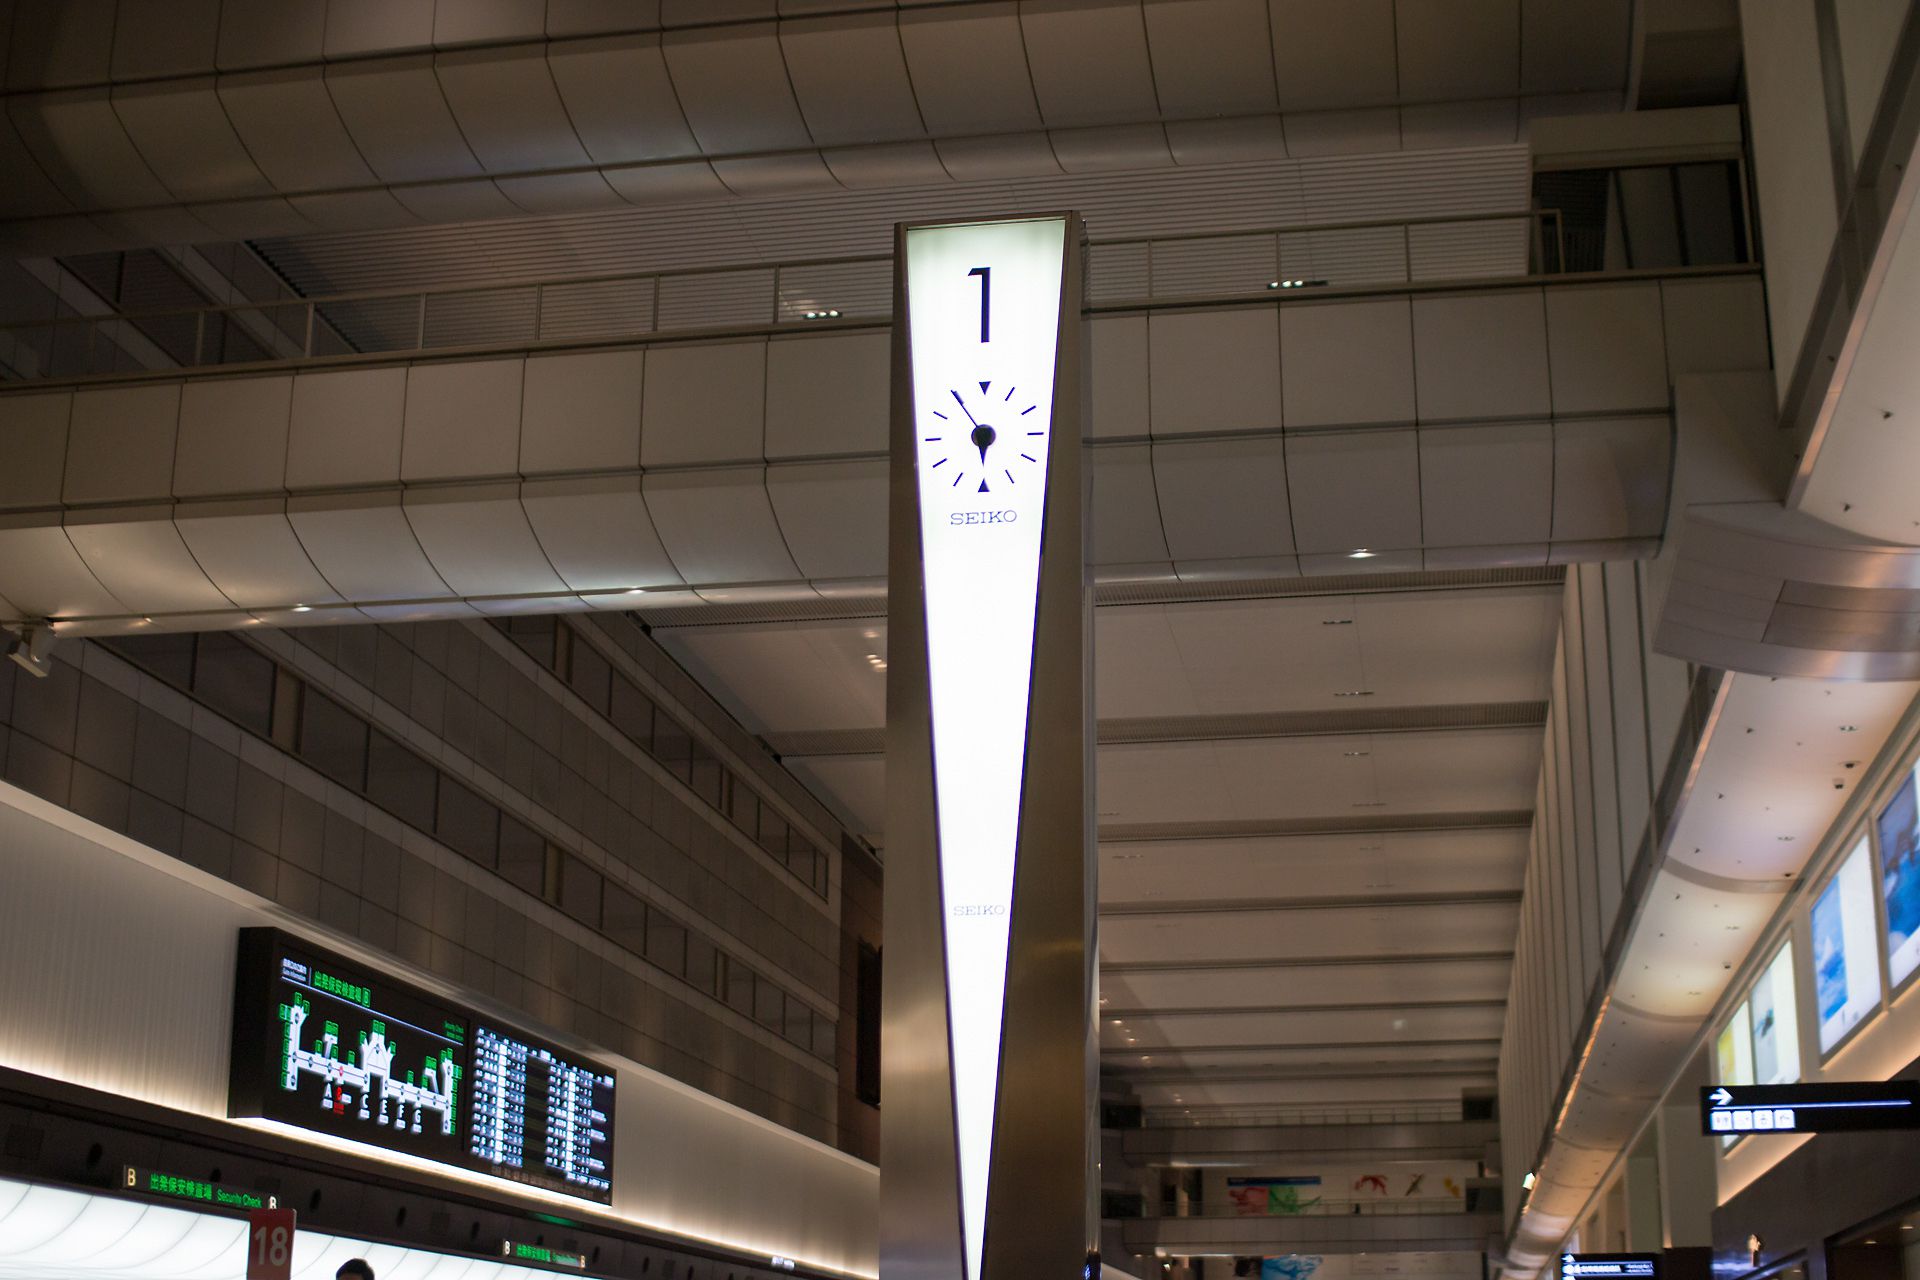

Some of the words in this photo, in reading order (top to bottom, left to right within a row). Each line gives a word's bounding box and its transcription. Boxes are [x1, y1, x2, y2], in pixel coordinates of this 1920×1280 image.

[968, 267, 991, 343] 1
[950, 509, 1018, 525] SEIKO
[953, 904, 1005, 916] SEIKO
[325, 1083, 332, 1098] A
[362, 1094, 369, 1109] C
[382, 1099, 388, 1114] E
[398, 1104, 405, 1118] F
[414, 1109, 421, 1124] G
[127, 1168, 137, 1186] B
[150, 1173, 212, 1201] 出発保安検査場
[217, 1188, 242, 1207] Security
[242, 1193, 262, 1209] Check
[254, 1226, 288, 1267] 18
